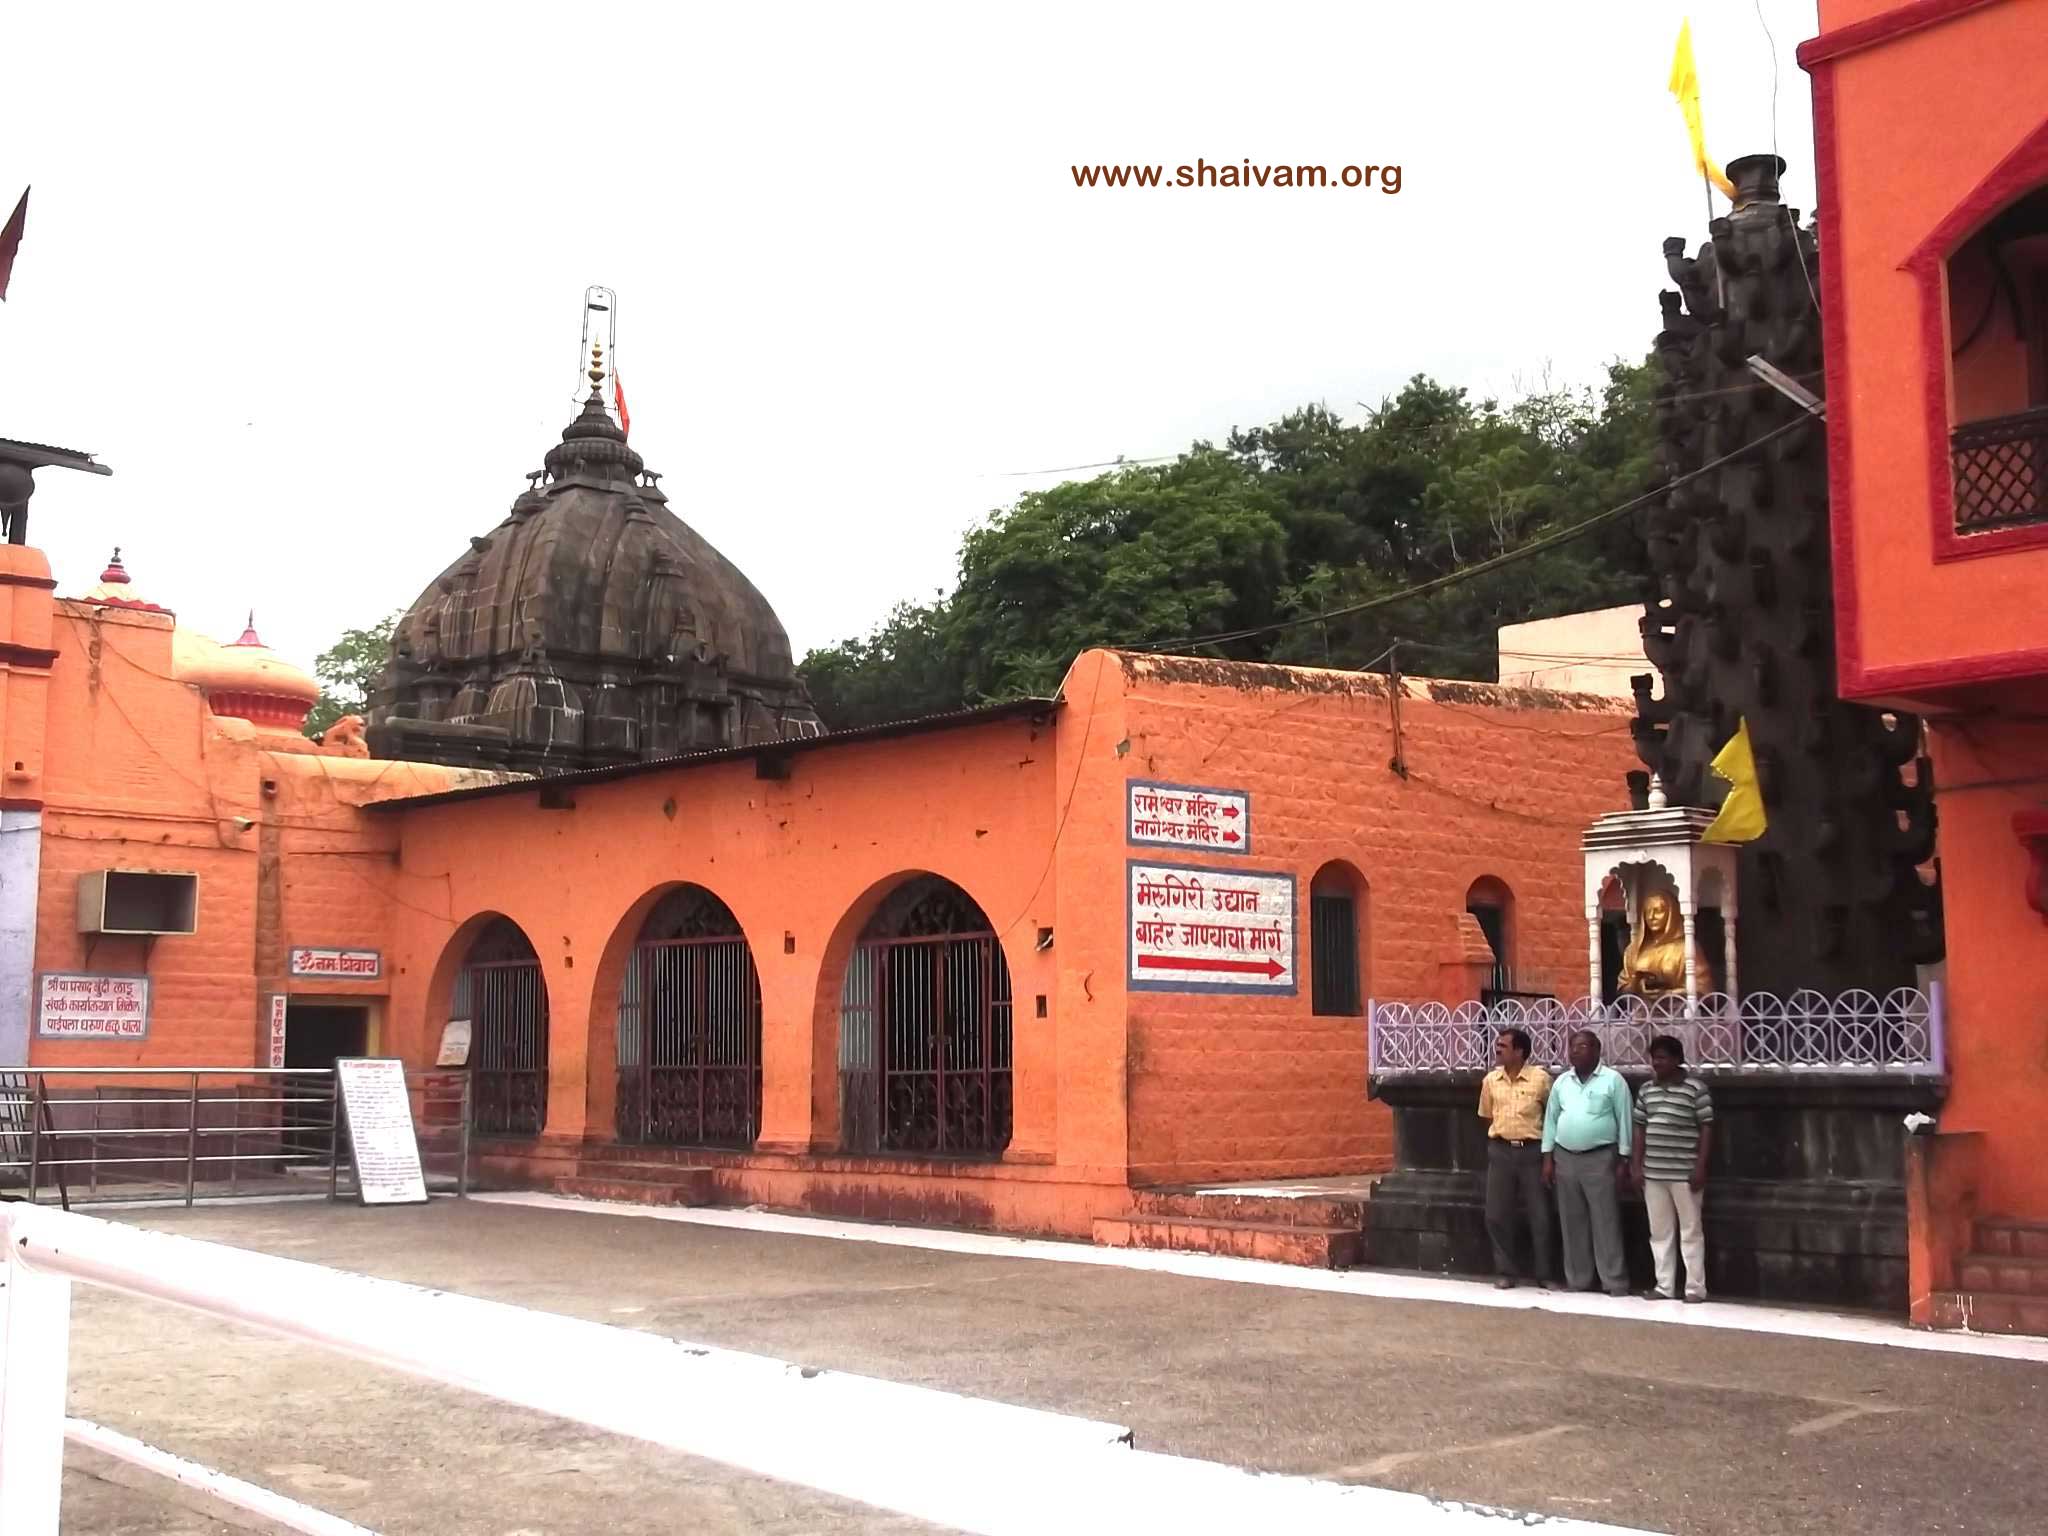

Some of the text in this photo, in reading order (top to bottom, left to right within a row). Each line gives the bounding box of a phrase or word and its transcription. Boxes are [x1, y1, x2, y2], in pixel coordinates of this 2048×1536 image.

[1134, 789, 1218, 820] रामेश्वर मंदिर
[1134, 815, 1219, 843] नागेश्वर मंदिर
[1212, 887, 1260, 913] उद्यान
[1136, 913, 1284, 952] बाहेर जाण्याचा मार्ग
